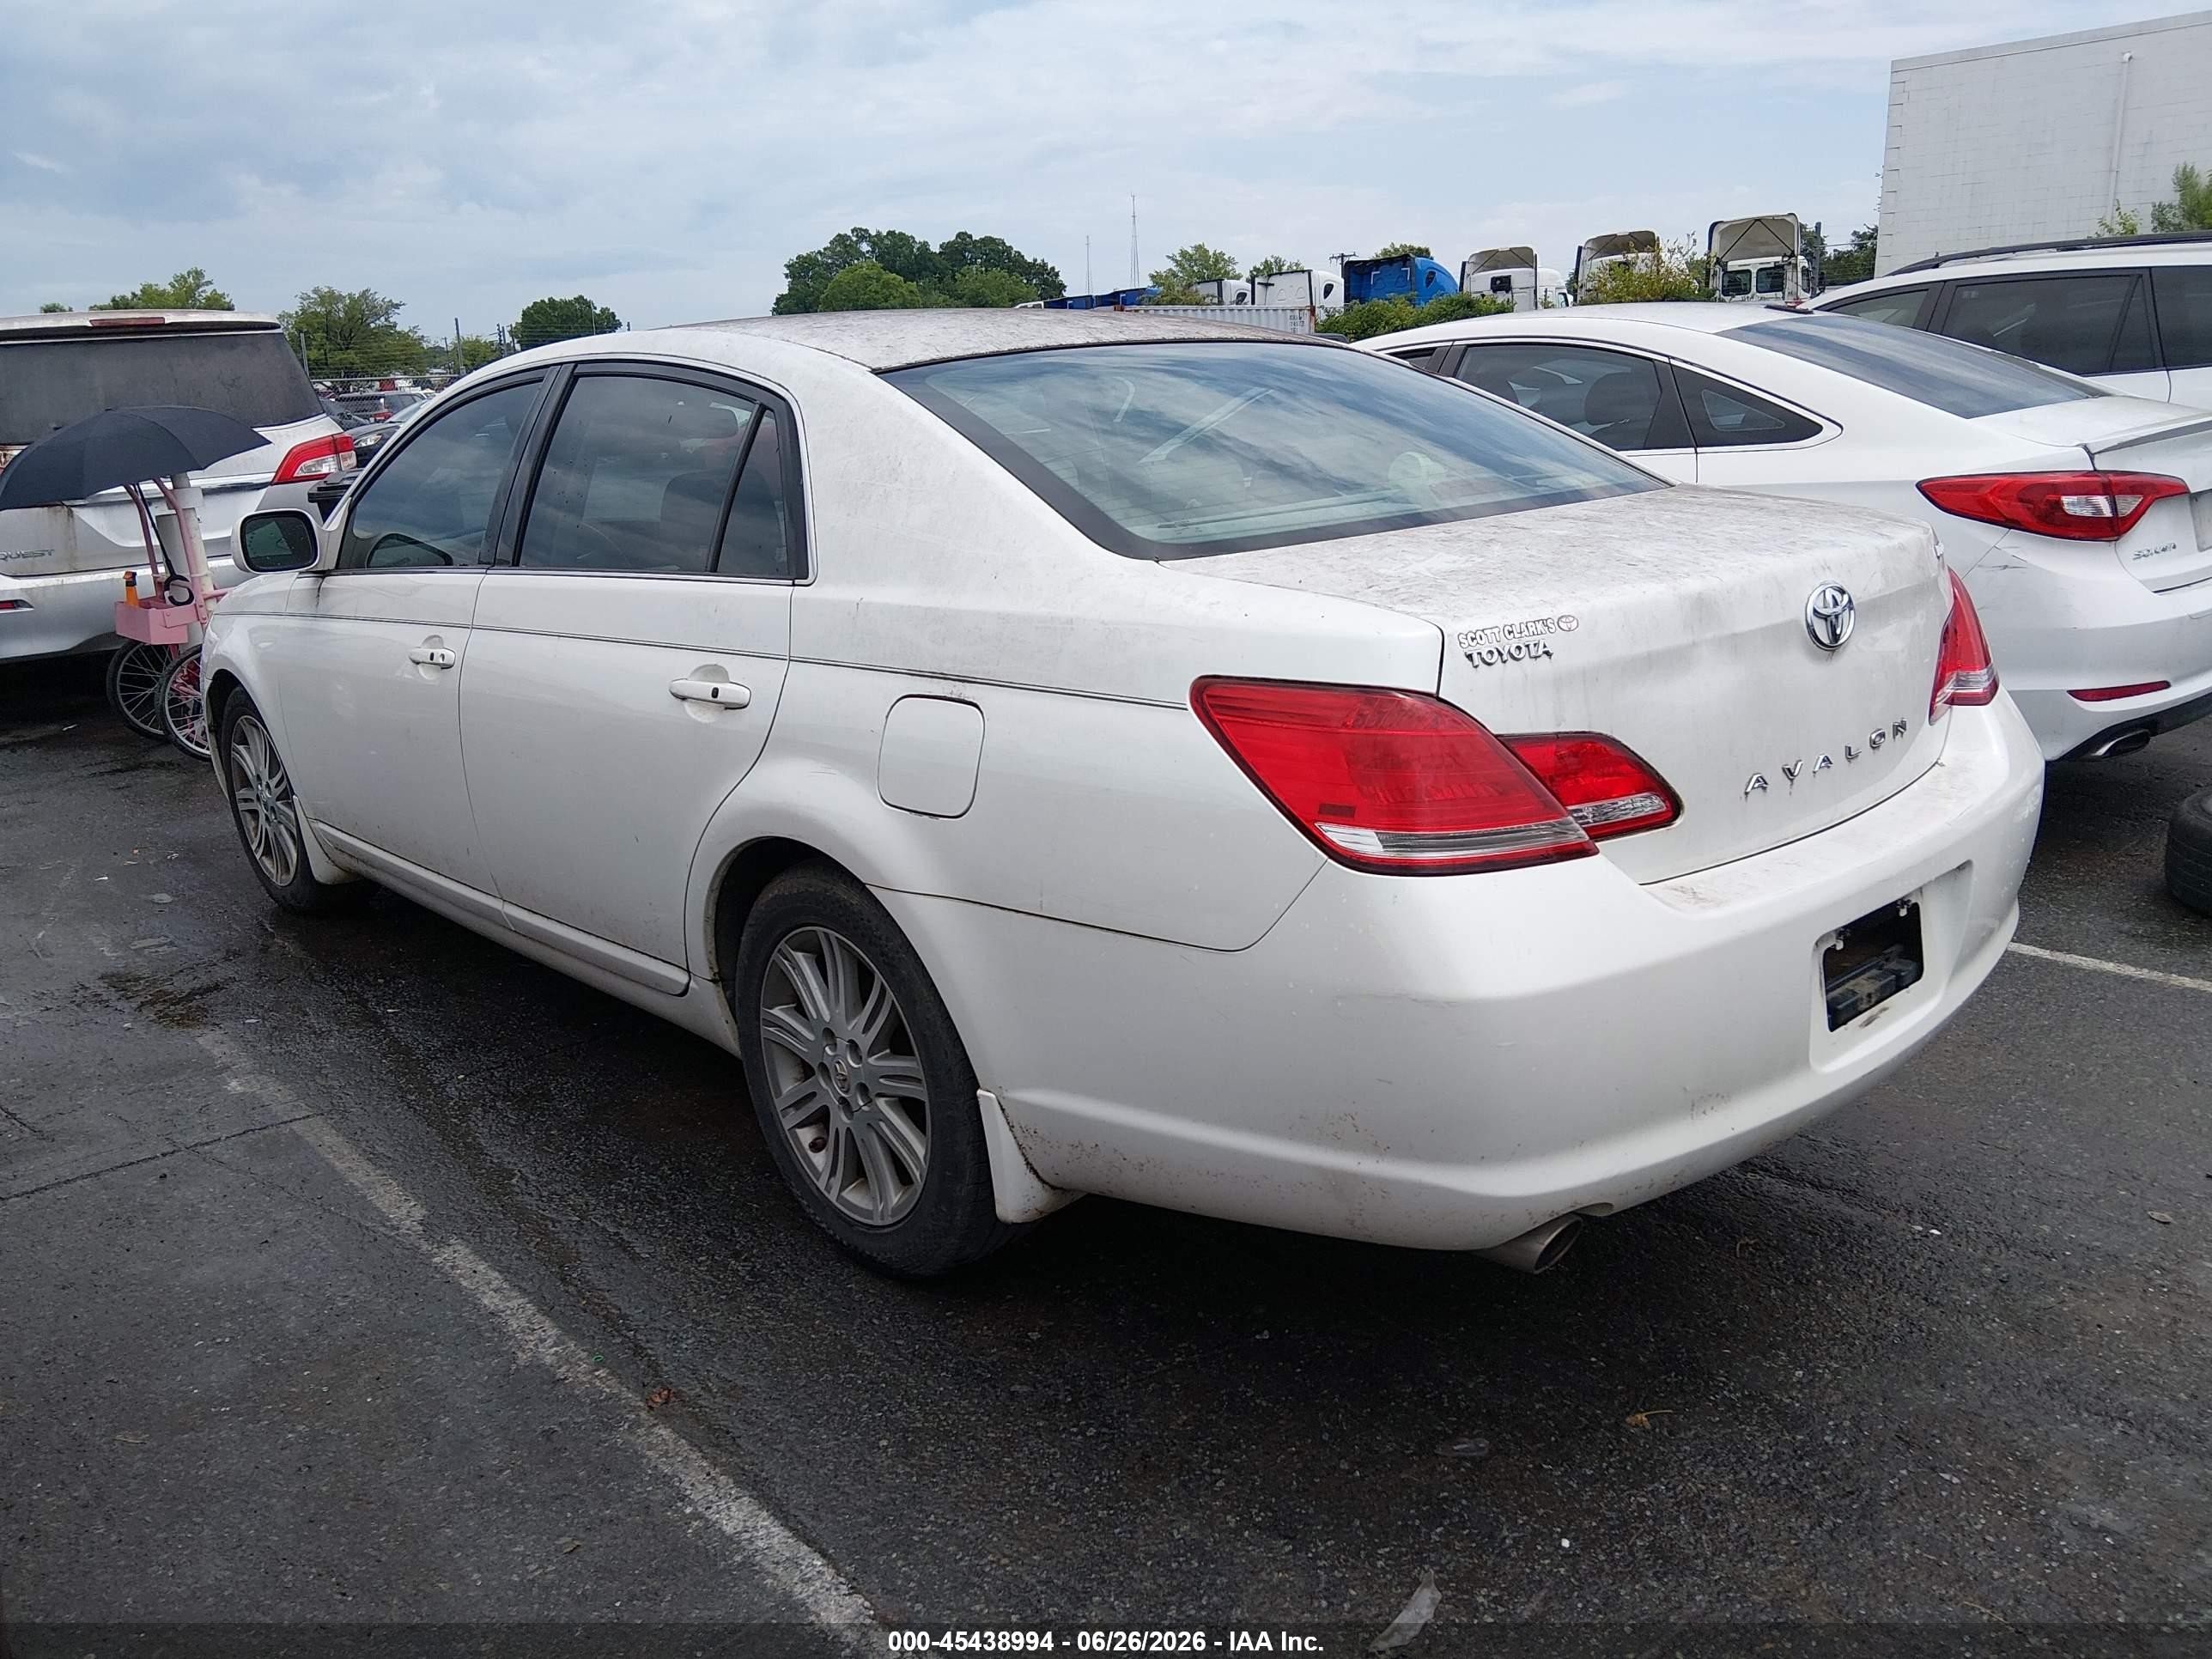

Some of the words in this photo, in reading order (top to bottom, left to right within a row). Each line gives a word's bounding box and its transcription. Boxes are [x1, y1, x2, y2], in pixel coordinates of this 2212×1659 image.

[1457, 628, 1501, 649] SCOTT
[1502, 617, 1556, 641] CLARK'S
[1464, 639, 1553, 669] TOYOTA
[1745, 718, 1907, 797] AVALON
